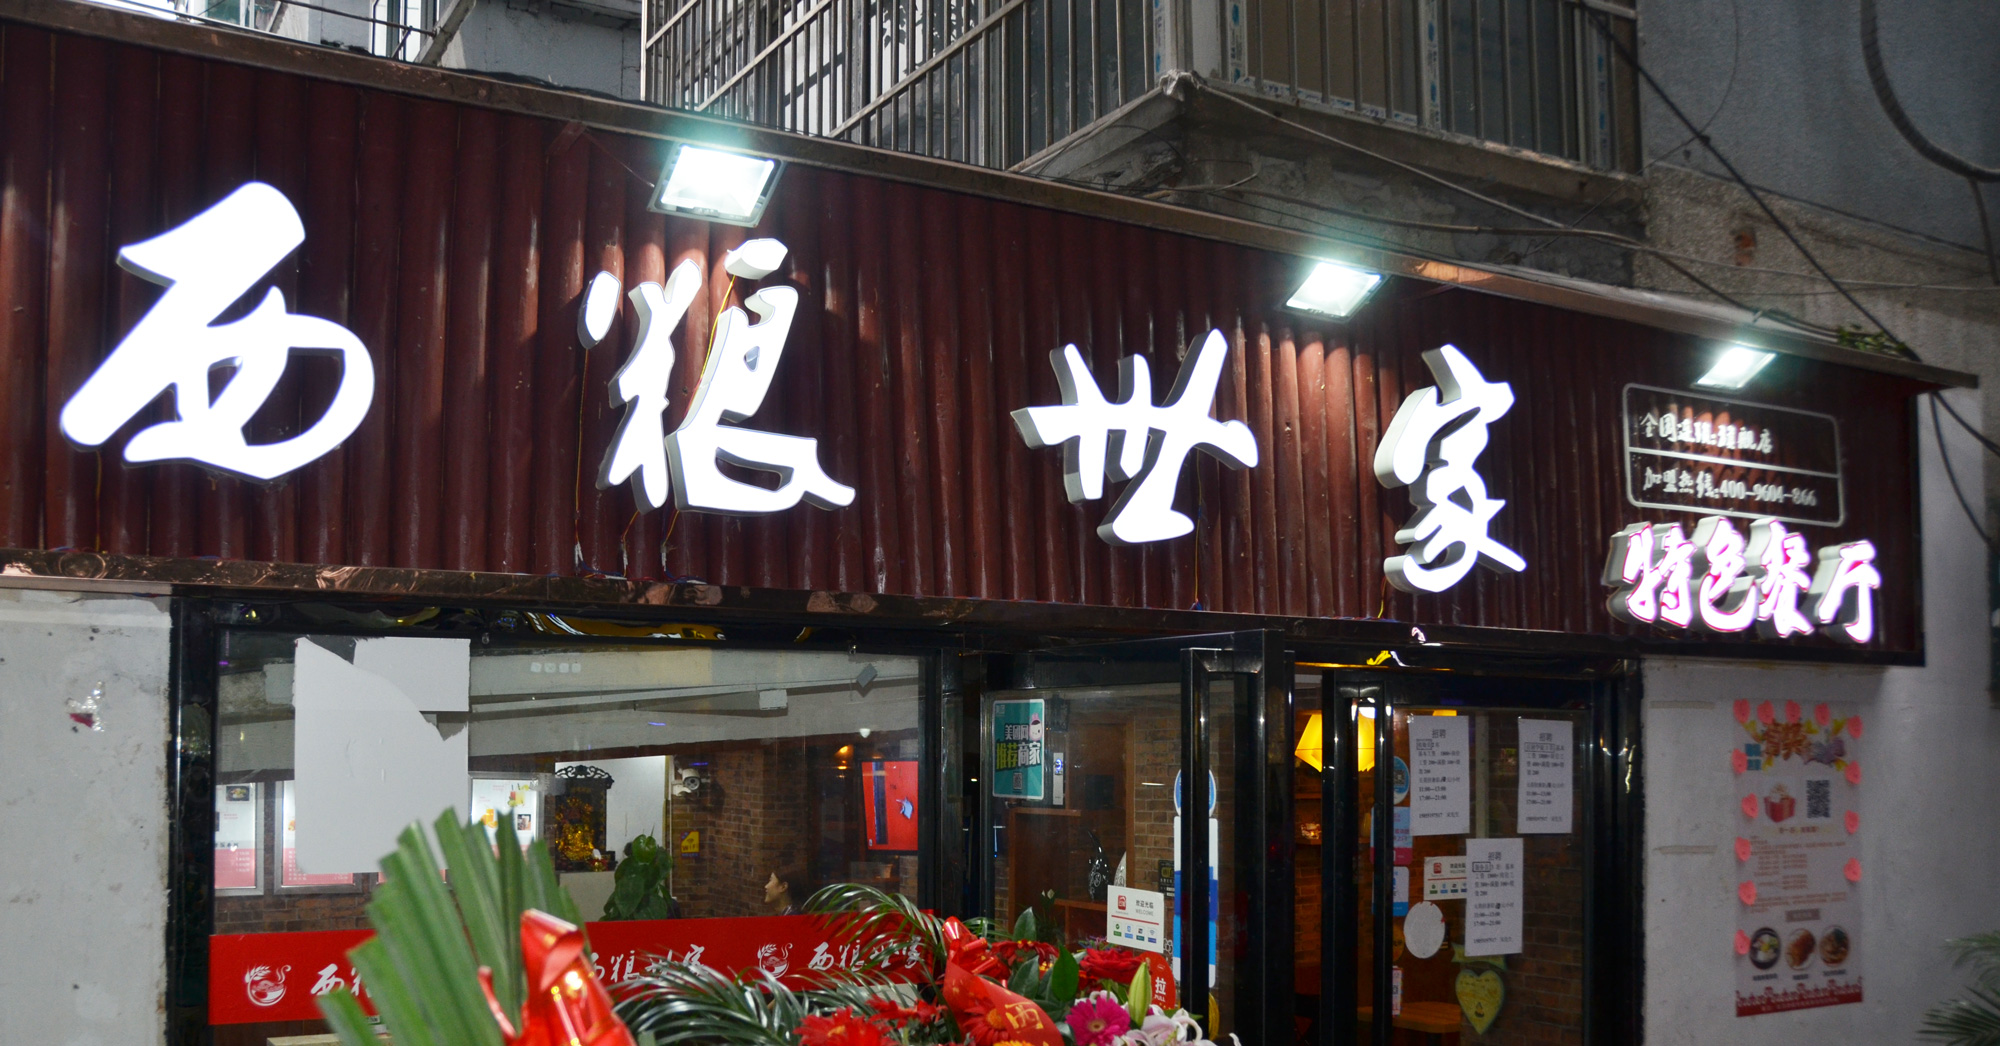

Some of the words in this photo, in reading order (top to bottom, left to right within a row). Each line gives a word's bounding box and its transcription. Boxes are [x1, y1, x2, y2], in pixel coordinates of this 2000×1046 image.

[1606, 516, 1882, 644] 特色餐厅
[996, 741, 1041, 770] 推荐商家
[1135, 899, 1154, 909] 欢迎光临
[1154, 976, 1167, 995] 拉
